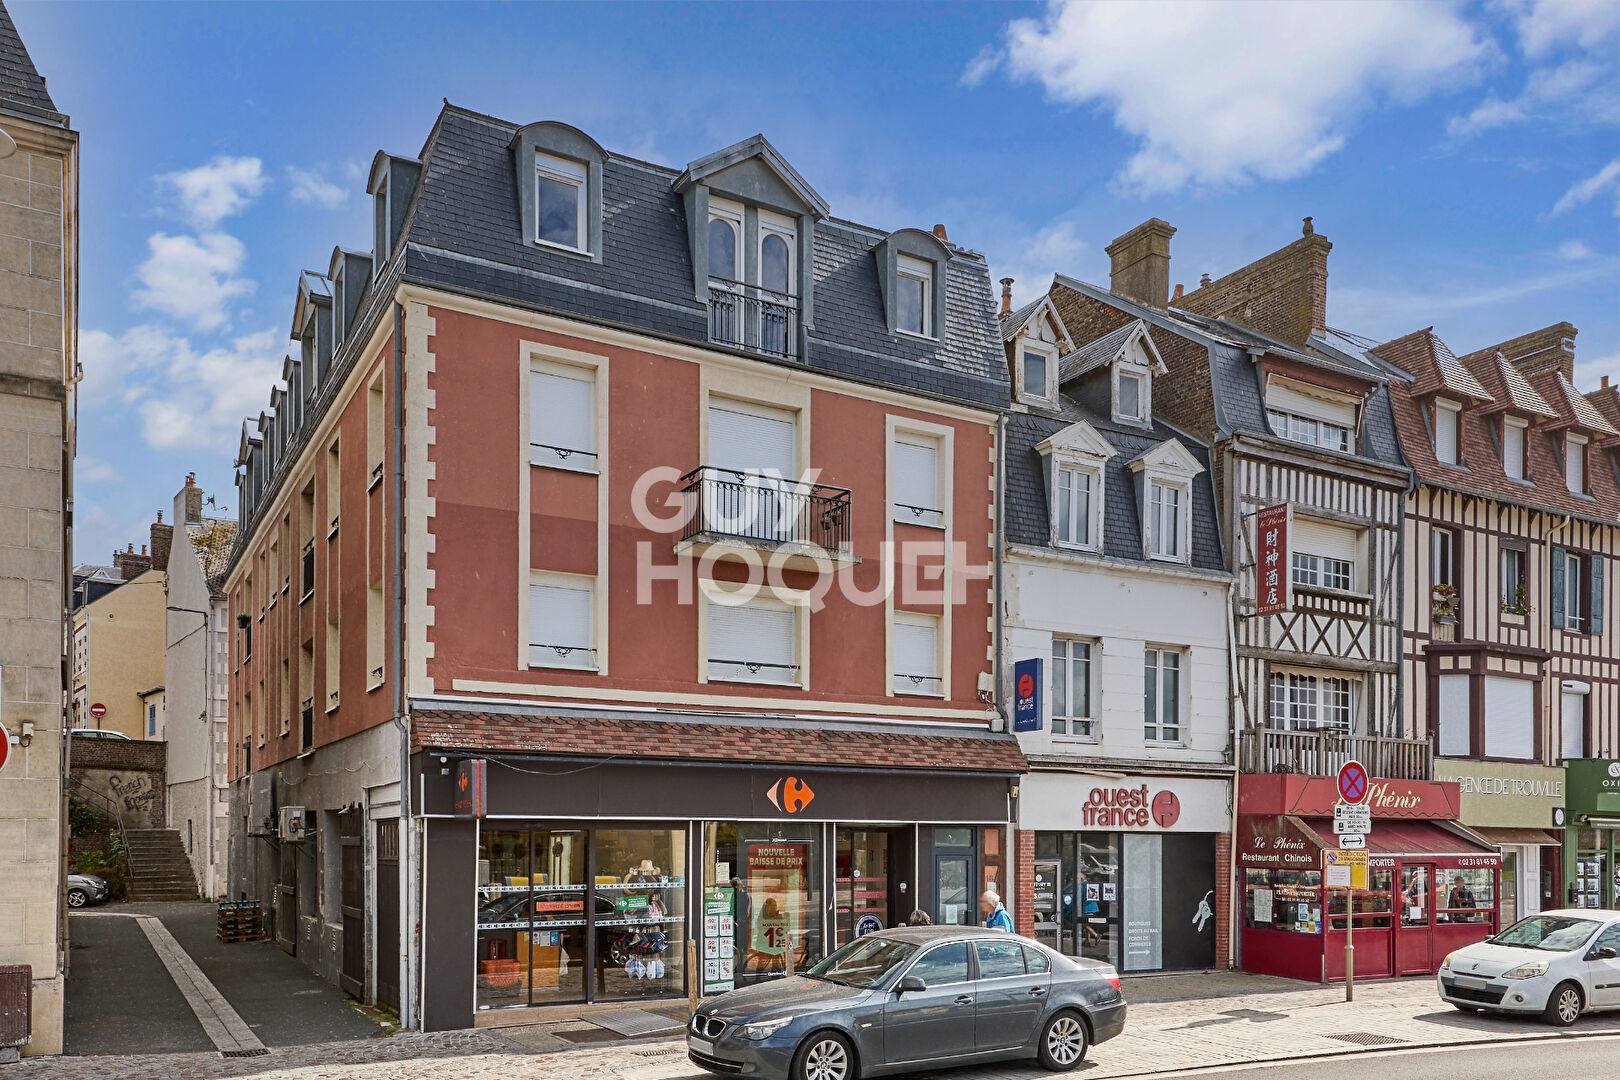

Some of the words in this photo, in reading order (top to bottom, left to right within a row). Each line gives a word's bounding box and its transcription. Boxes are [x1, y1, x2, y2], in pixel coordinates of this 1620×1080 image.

[1265, 528, 1279, 605] 財神酒店
[1494, 778, 1510, 795] DE
[1511, 780, 1562, 798] TROUVILLE
[1089, 784, 1149, 808] ouest
[1082, 801, 1149, 827] france
[1273, 836, 1306, 850] Phénix
[758, 848, 795, 857] NOUVELLE
[1242, 852, 1280, 863] Restaurant
[1284, 853, 1313, 863] Chinois
[749, 857, 774, 866] BAISSE
[775, 857, 785, 866] DE
[786, 857, 803, 866] PRIX
[1368, 859, 1396, 867] MPORTER
[1469, 858, 1476, 866] 31
[1476, 858, 1483, 866] 81
